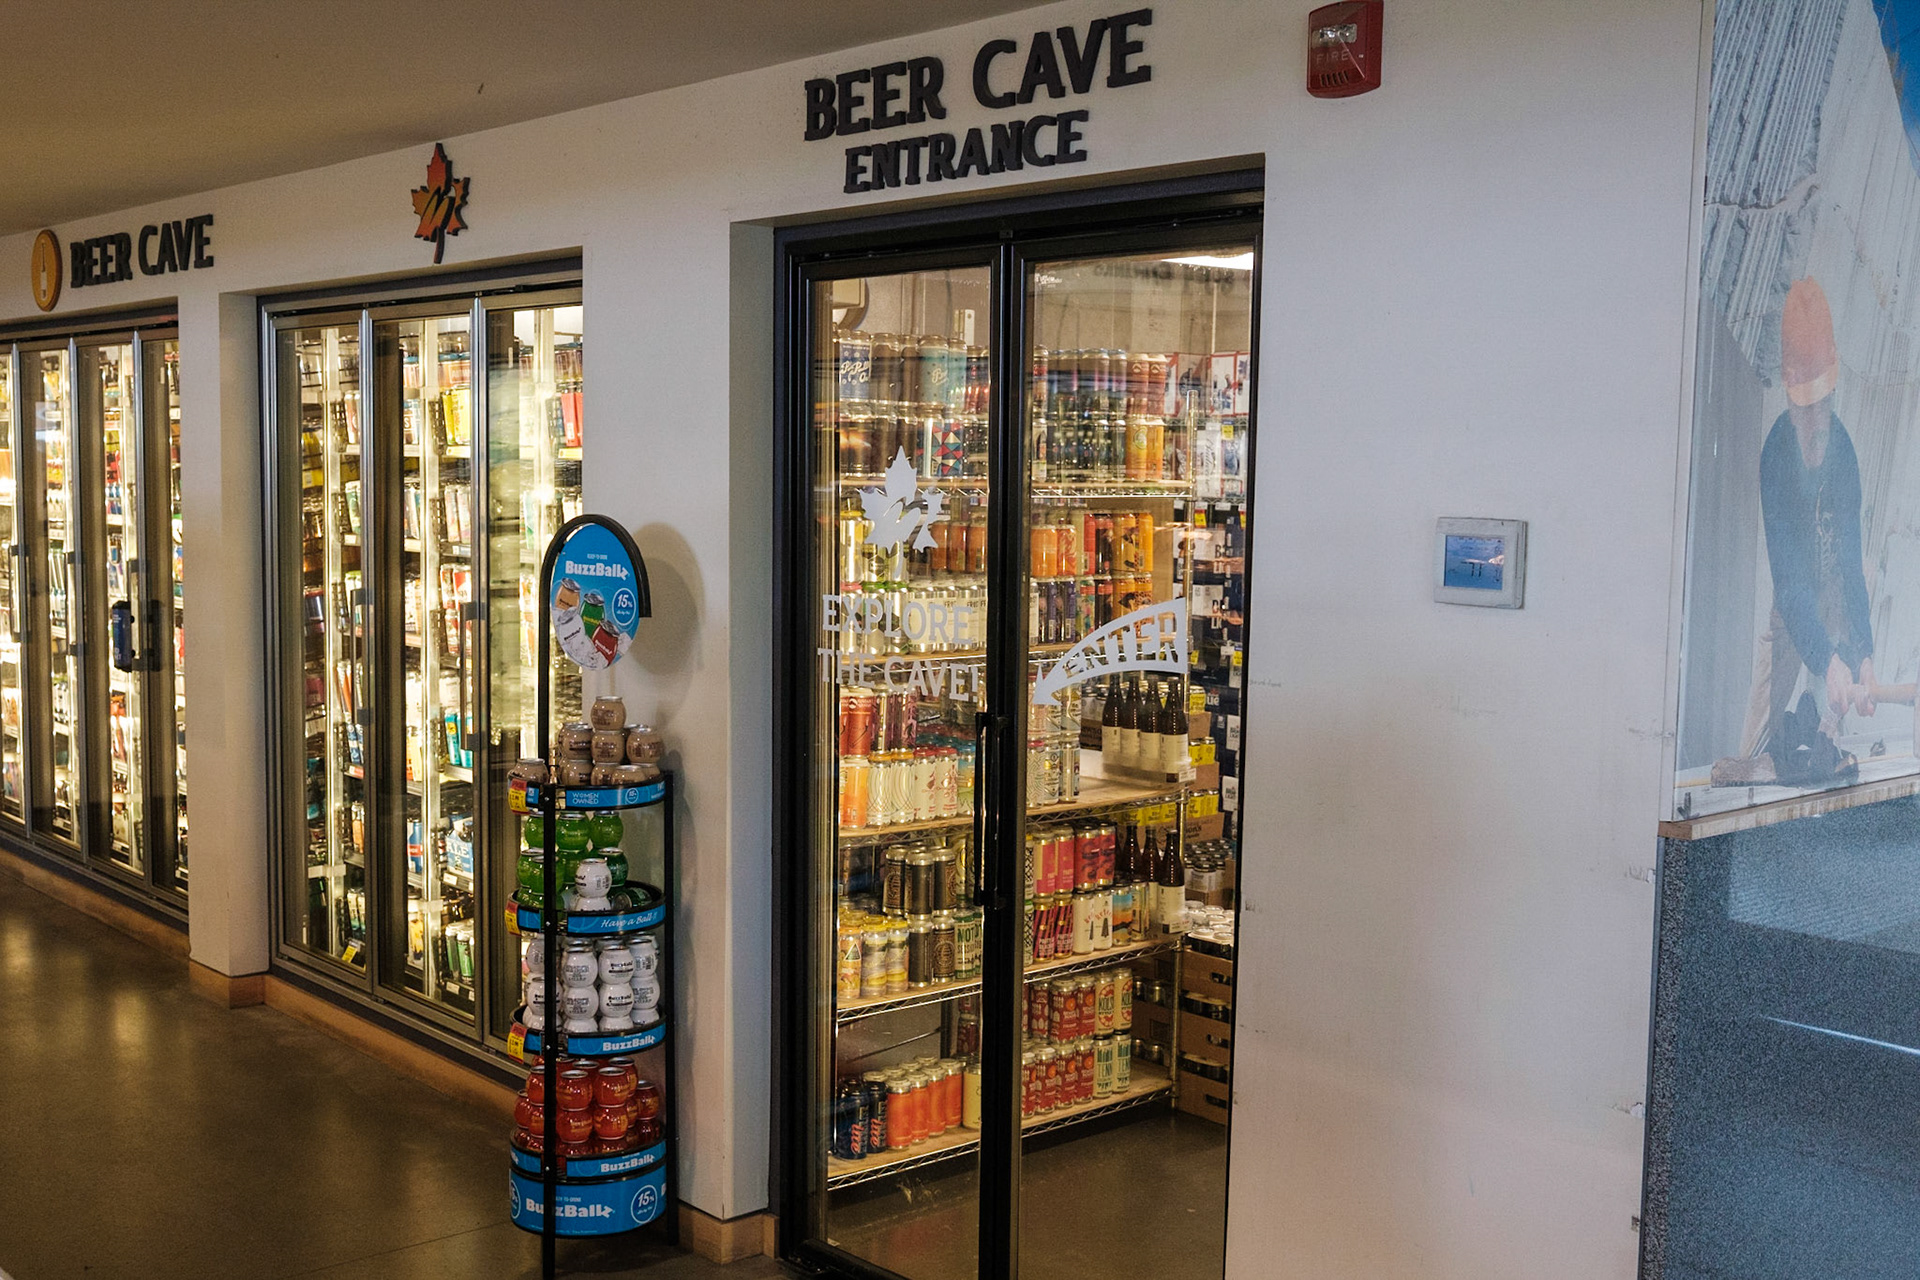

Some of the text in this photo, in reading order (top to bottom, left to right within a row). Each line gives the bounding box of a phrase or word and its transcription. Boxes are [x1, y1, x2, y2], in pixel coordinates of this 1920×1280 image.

[1316, 49, 1349, 65] FIRE
[804, 8, 1152, 141] BEER CAVE
[844, 109, 1088, 194] ENTRANCE
[70, 213, 215, 288] BEER CAVE
[565, 561, 629, 580] BuzzBallz
[822, 594, 973, 645] EXPLORE
[1062, 611, 1179, 679] ENTER
[818, 647, 979, 702] THE CAVE!
[601, 917, 628, 928] Have
[602, 1036, 656, 1051] BuzzBallz
[600, 1155, 655, 1173] BuzzBallz
[525, 1197, 614, 1219] BuzBallz
[637, 1191, 655, 1208] 15%
